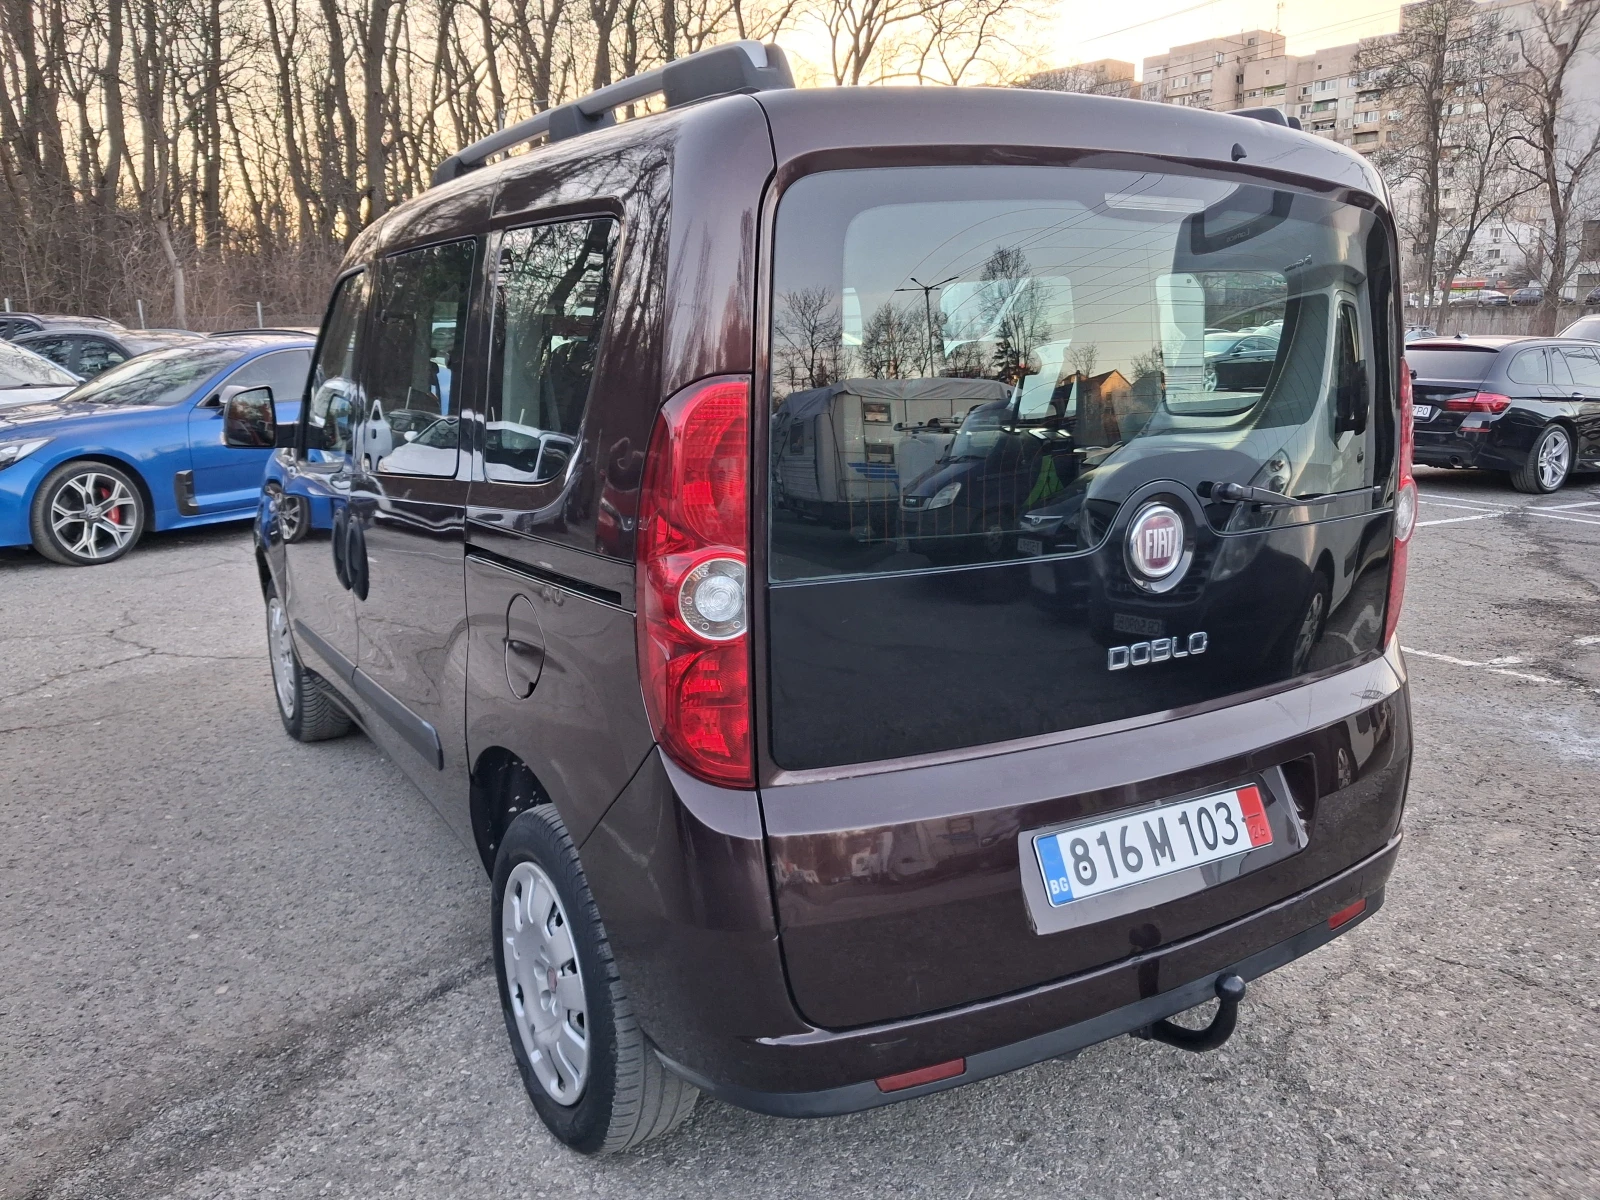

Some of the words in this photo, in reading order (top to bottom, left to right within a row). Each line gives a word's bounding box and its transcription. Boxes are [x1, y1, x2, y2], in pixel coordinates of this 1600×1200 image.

[1145, 527, 1175, 560] FIAT
[1107, 631, 1208, 671] DOBLO
[1069, 825, 1143, 886] 816
[1142, 816, 1176, 867] M
[1177, 801, 1239, 857] 103
[1049, 877, 1069, 895] BG
